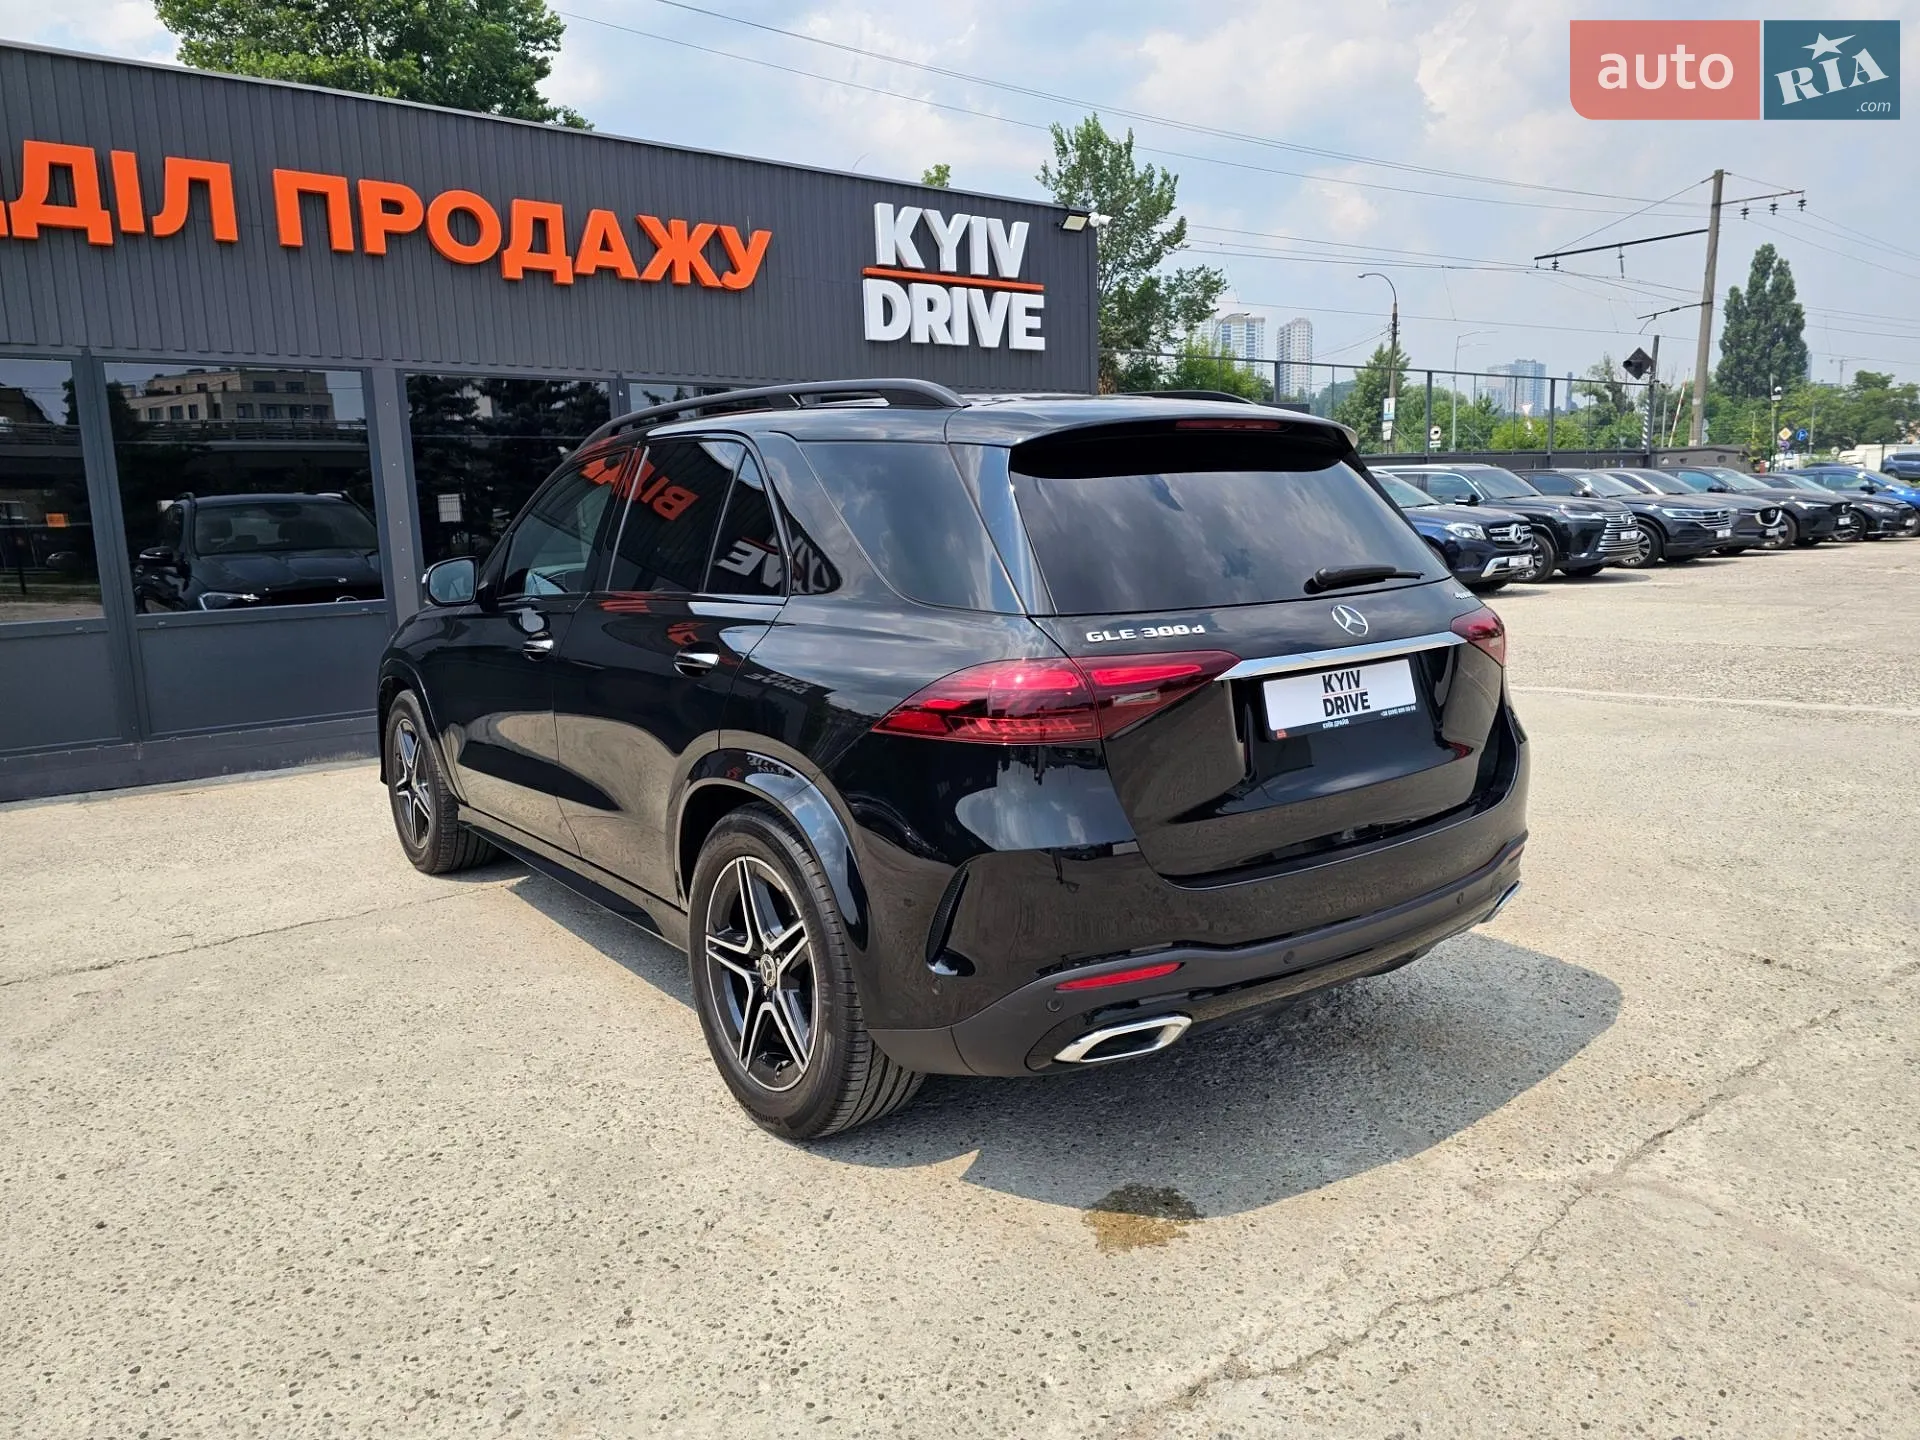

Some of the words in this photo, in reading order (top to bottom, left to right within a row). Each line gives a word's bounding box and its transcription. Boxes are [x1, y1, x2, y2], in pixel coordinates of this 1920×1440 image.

[0, 139, 239, 246] ДІЛ
[272, 168, 772, 291] ПРОДАЖУ
[873, 202, 1030, 279] KYIV
[863, 278, 1046, 351] DRIVE
[1085, 629, 1137, 643] GLE
[1321, 669, 1361, 694] KYIV
[1322, 691, 1371, 718] DRIVE
